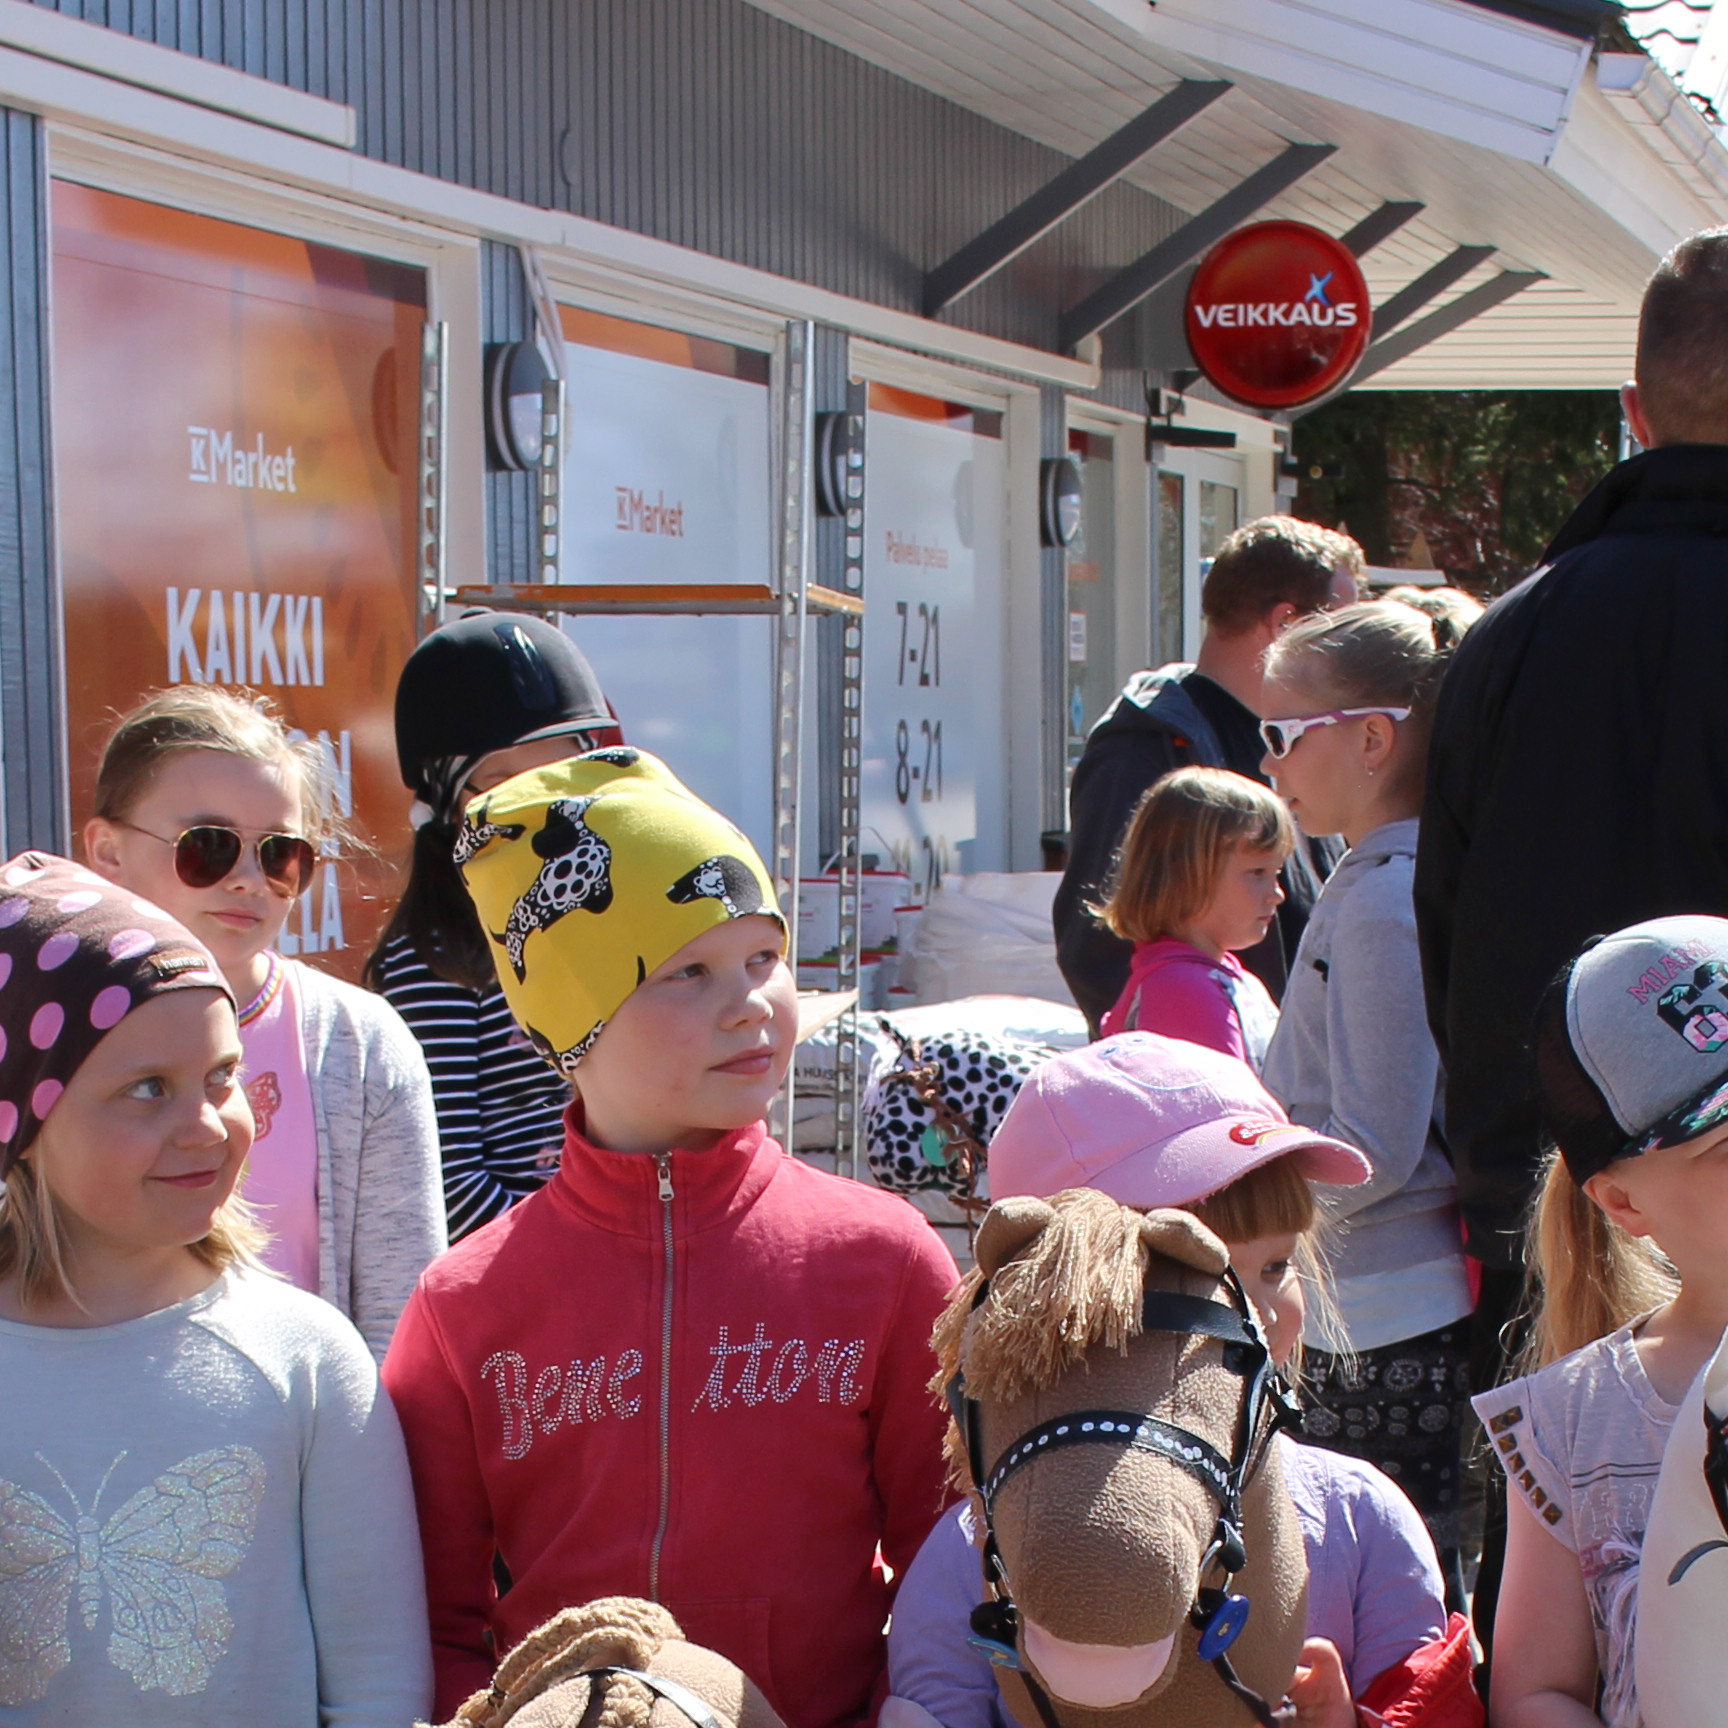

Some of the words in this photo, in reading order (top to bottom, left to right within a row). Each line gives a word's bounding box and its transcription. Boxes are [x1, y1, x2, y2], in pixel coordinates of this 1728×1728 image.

[1194, 303, 1358, 328] VEIKKAUS
[166, 586, 325, 686] KAIKKI
[896, 601, 940, 687] 7-21
[896, 719, 943, 805] 8-21
[1626, 939, 1716, 1005] MIAMI
